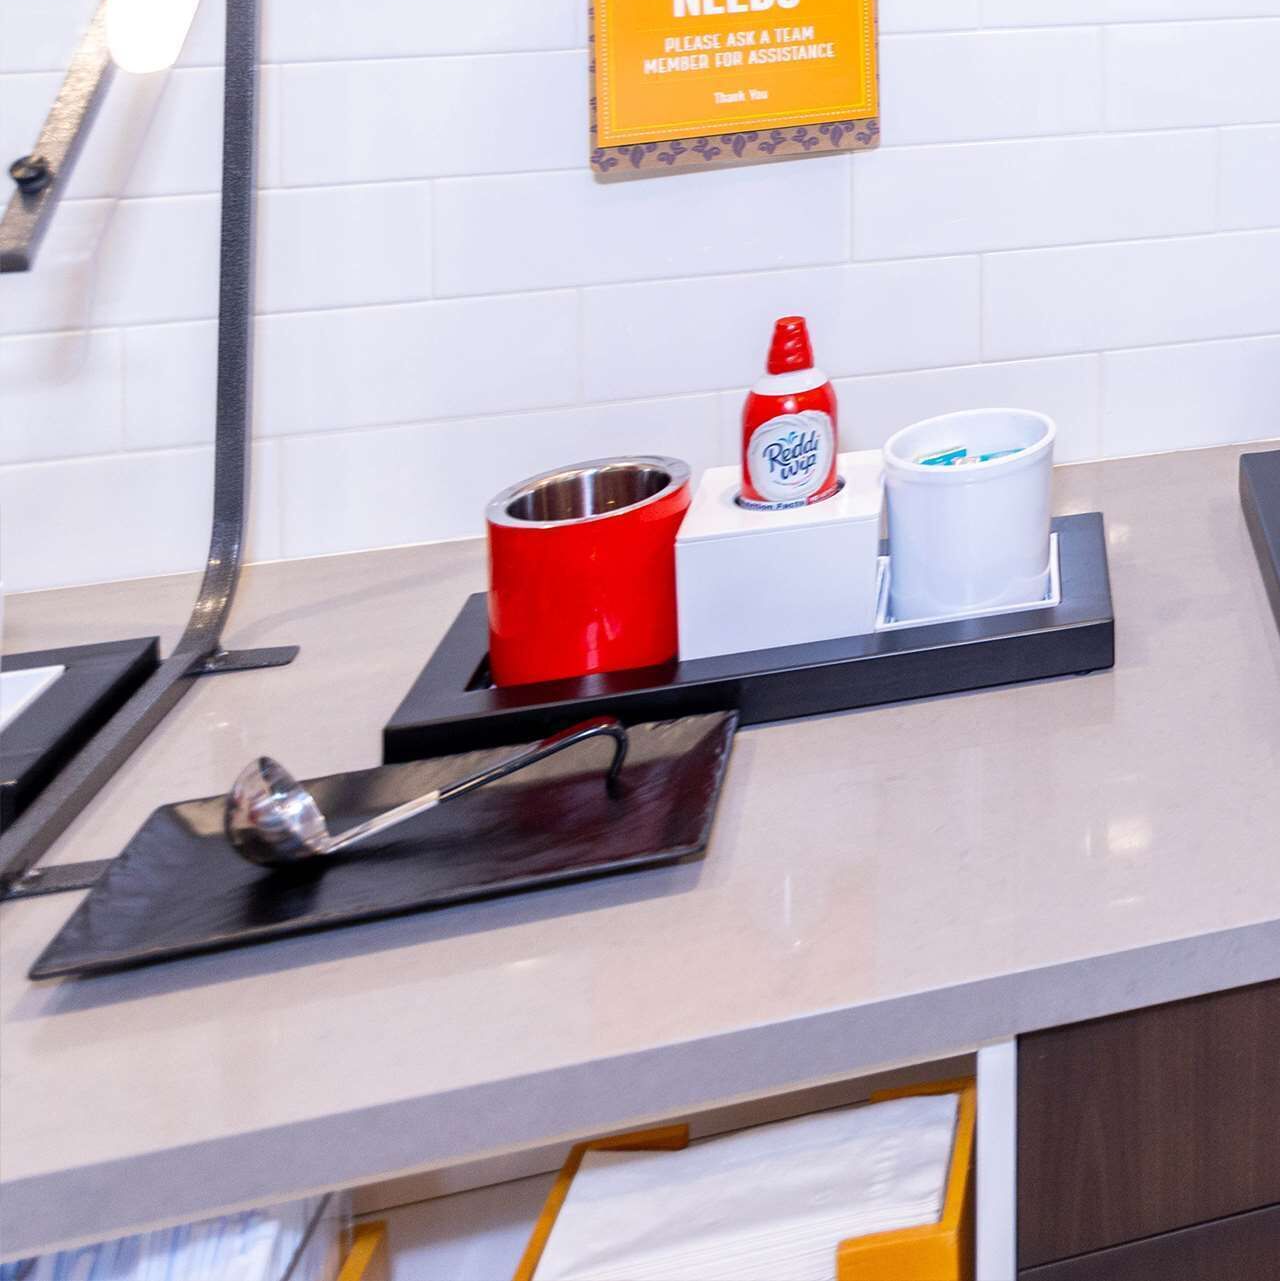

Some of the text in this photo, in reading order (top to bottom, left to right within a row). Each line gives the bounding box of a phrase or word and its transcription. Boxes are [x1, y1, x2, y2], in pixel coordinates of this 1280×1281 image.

[664, 26, 815, 53] PLEASE ASK A TEAM
[643, 42, 836, 75] MEMBER FOR ASSISTANCE
[713, 88, 769, 105] Thank You
[762, 430, 821, 473] Reddi
[781, 454, 817, 480] wip
